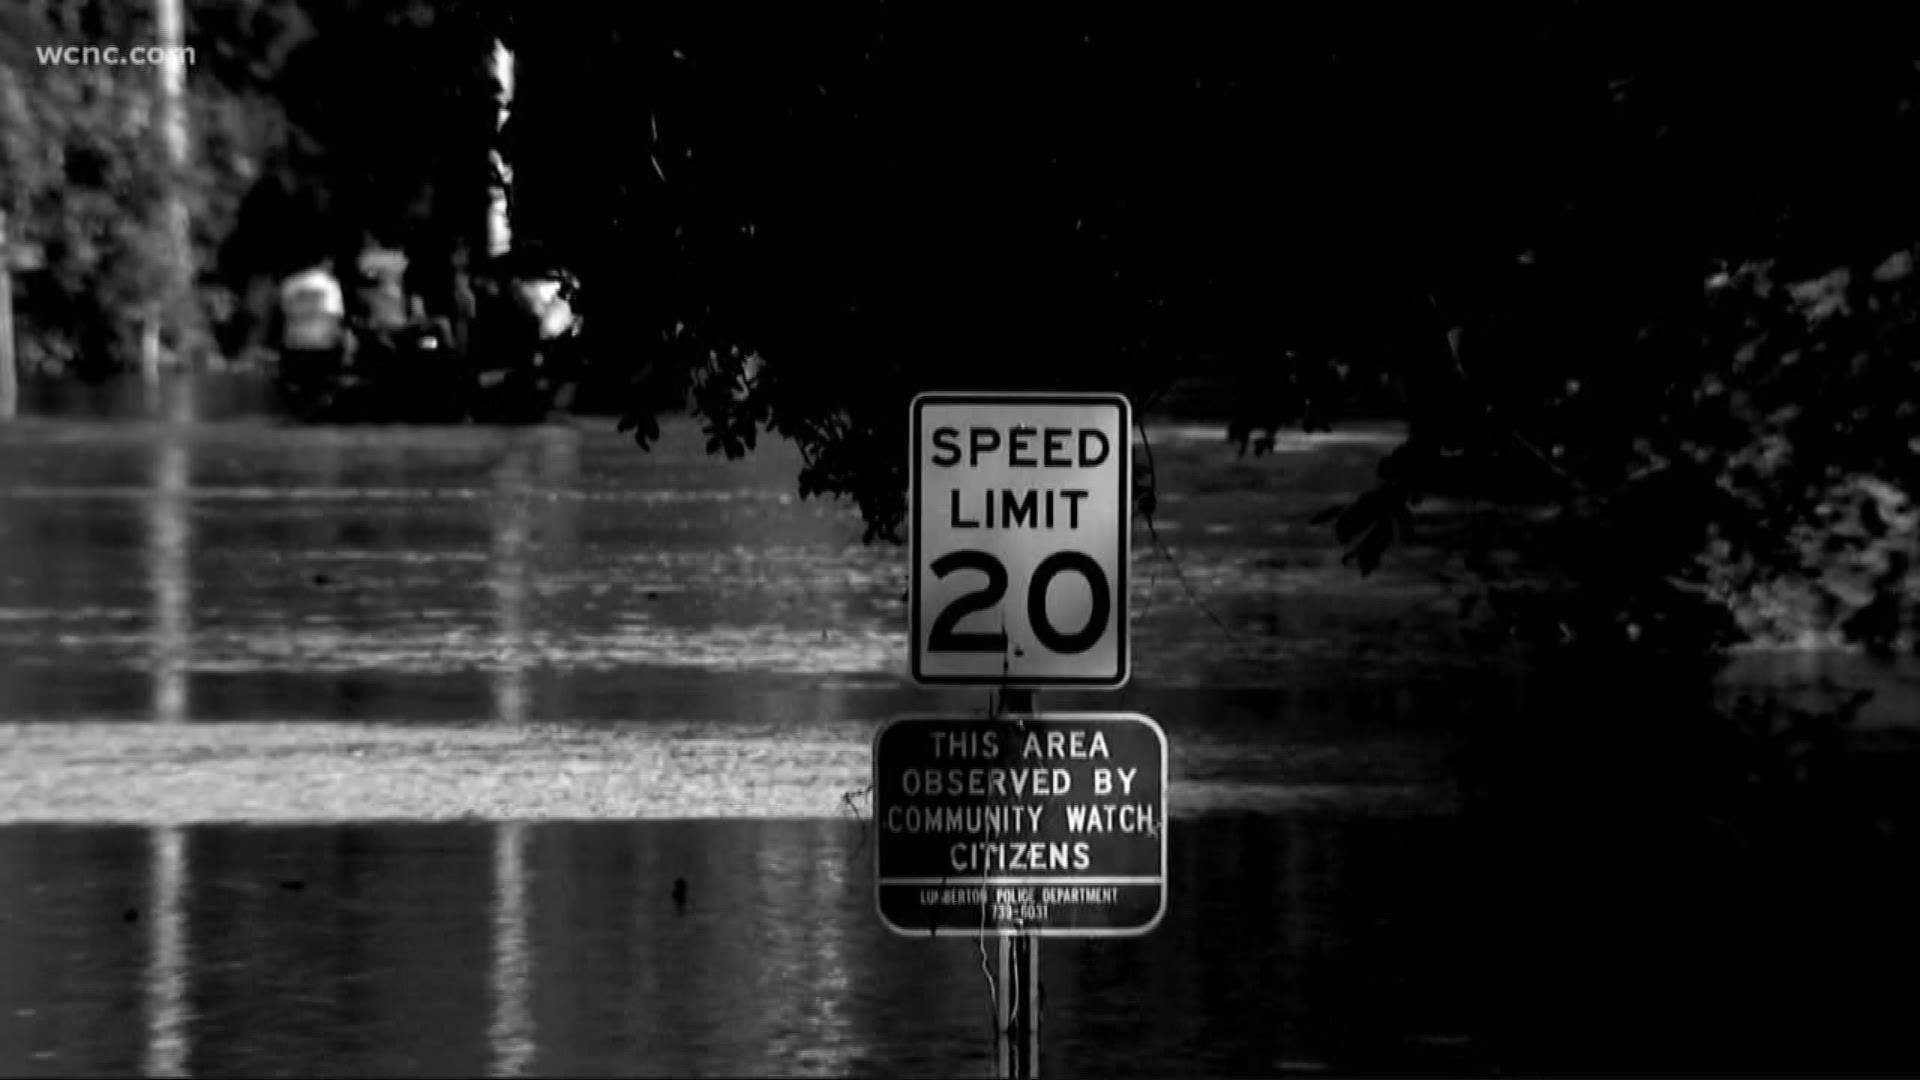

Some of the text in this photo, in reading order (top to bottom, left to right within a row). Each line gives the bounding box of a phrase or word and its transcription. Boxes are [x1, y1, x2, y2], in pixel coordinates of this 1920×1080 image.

[931, 426, 1110, 468] SPEED
[951, 489, 1089, 529] LIMIT
[927, 550, 1111, 655] 20
[930, 731, 1110, 760] THIS AREA
[902, 768, 1138, 797] OBSERVED BY
[887, 805, 1154, 833] COMMUNITY WATCH
[950, 842, 1091, 871] CITIZENS
[1042, 887, 1118, 904] DEPARTMENT
